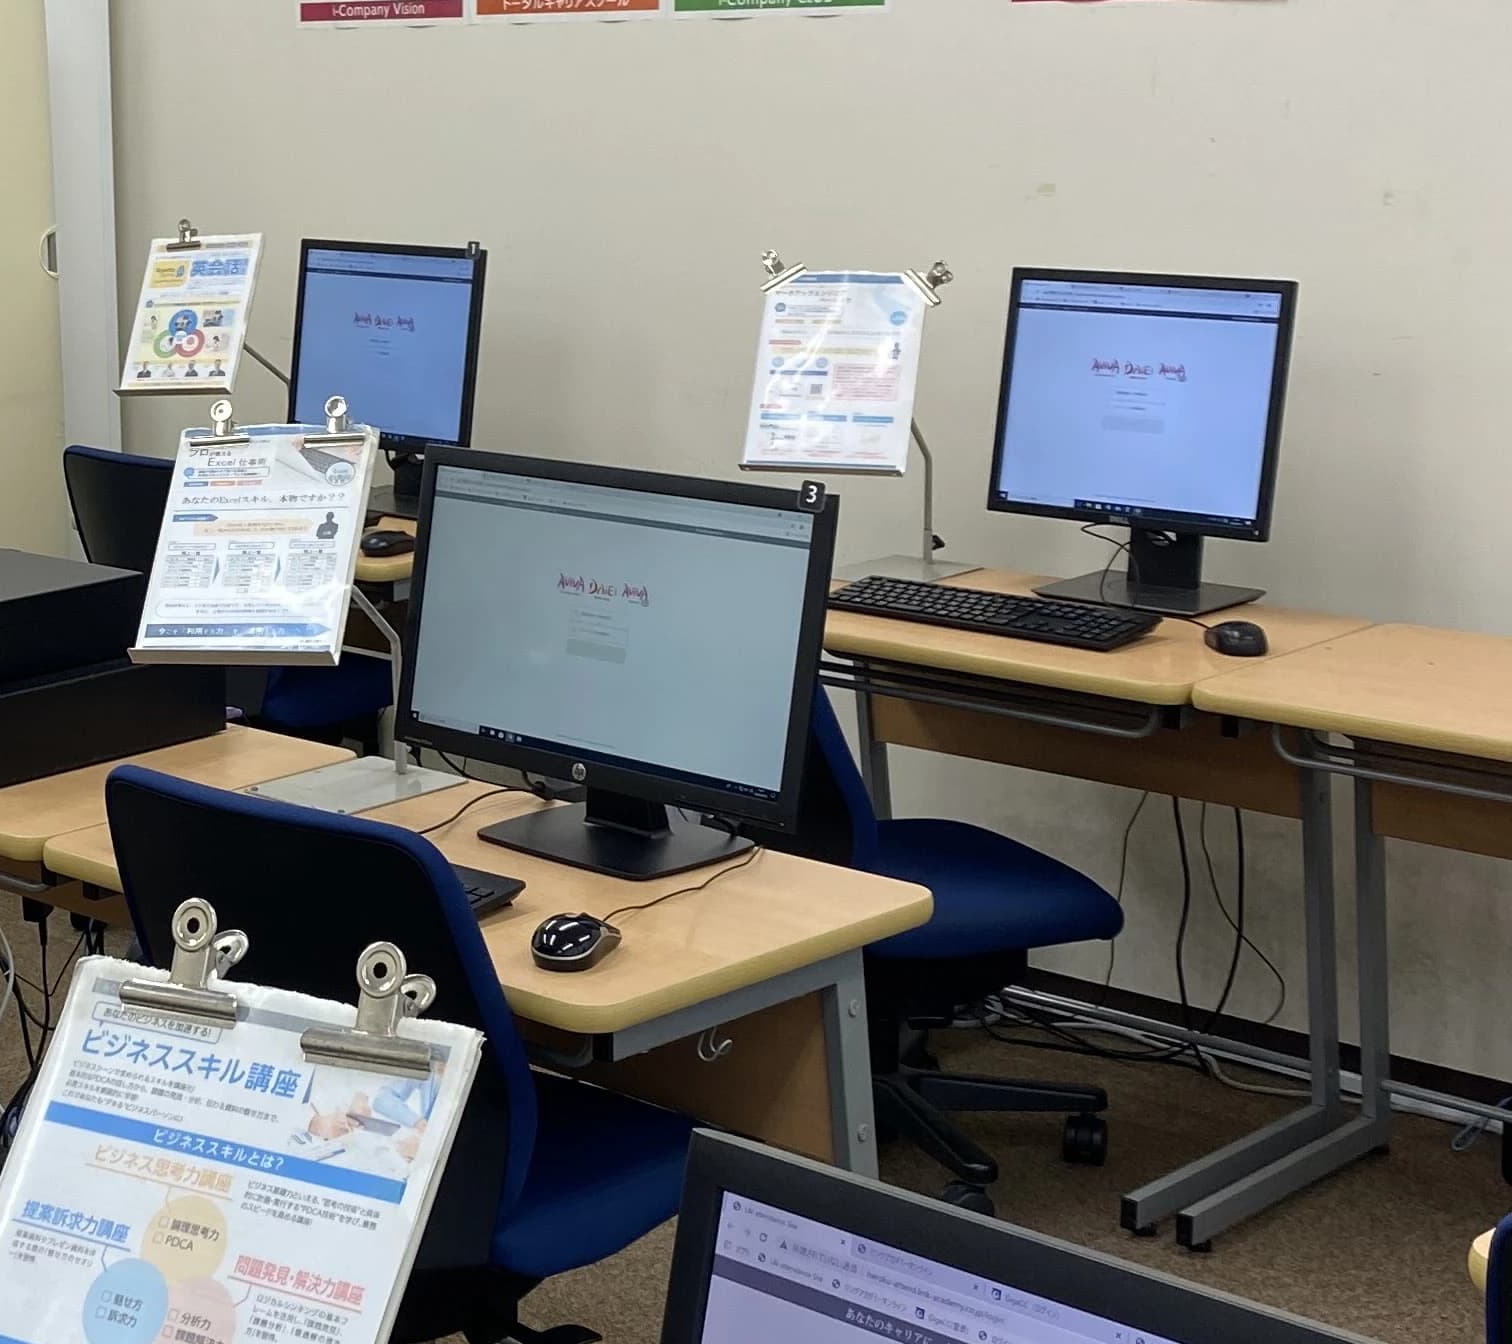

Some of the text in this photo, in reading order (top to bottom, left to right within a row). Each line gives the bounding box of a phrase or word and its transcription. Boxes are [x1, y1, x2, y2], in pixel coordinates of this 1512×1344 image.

[332, 2, 424, 19] i-Company Vision
[190, 258, 249, 277] 英会話
[207, 458, 235, 467] Excel
[806, 485, 817, 503] 3
[82, 1028, 302, 1100] ビジネススキル講座
[152, 1129, 285, 1170] ビジネススキルとは?
[94, 1144, 232, 1193] ビジネス思考力講座
[22, 1200, 131, 1243] 提案訴求力講座
[171, 1219, 219, 1242] 論理思考力
[165, 1235, 193, 1251] PDCA
[234, 1255, 365, 1306] 問題発見・解決力講座
[113, 1294, 143, 1312] 魅せ方
[107, 1310, 137, 1328] 訴求力
[180, 1312, 211, 1331] 分析力
